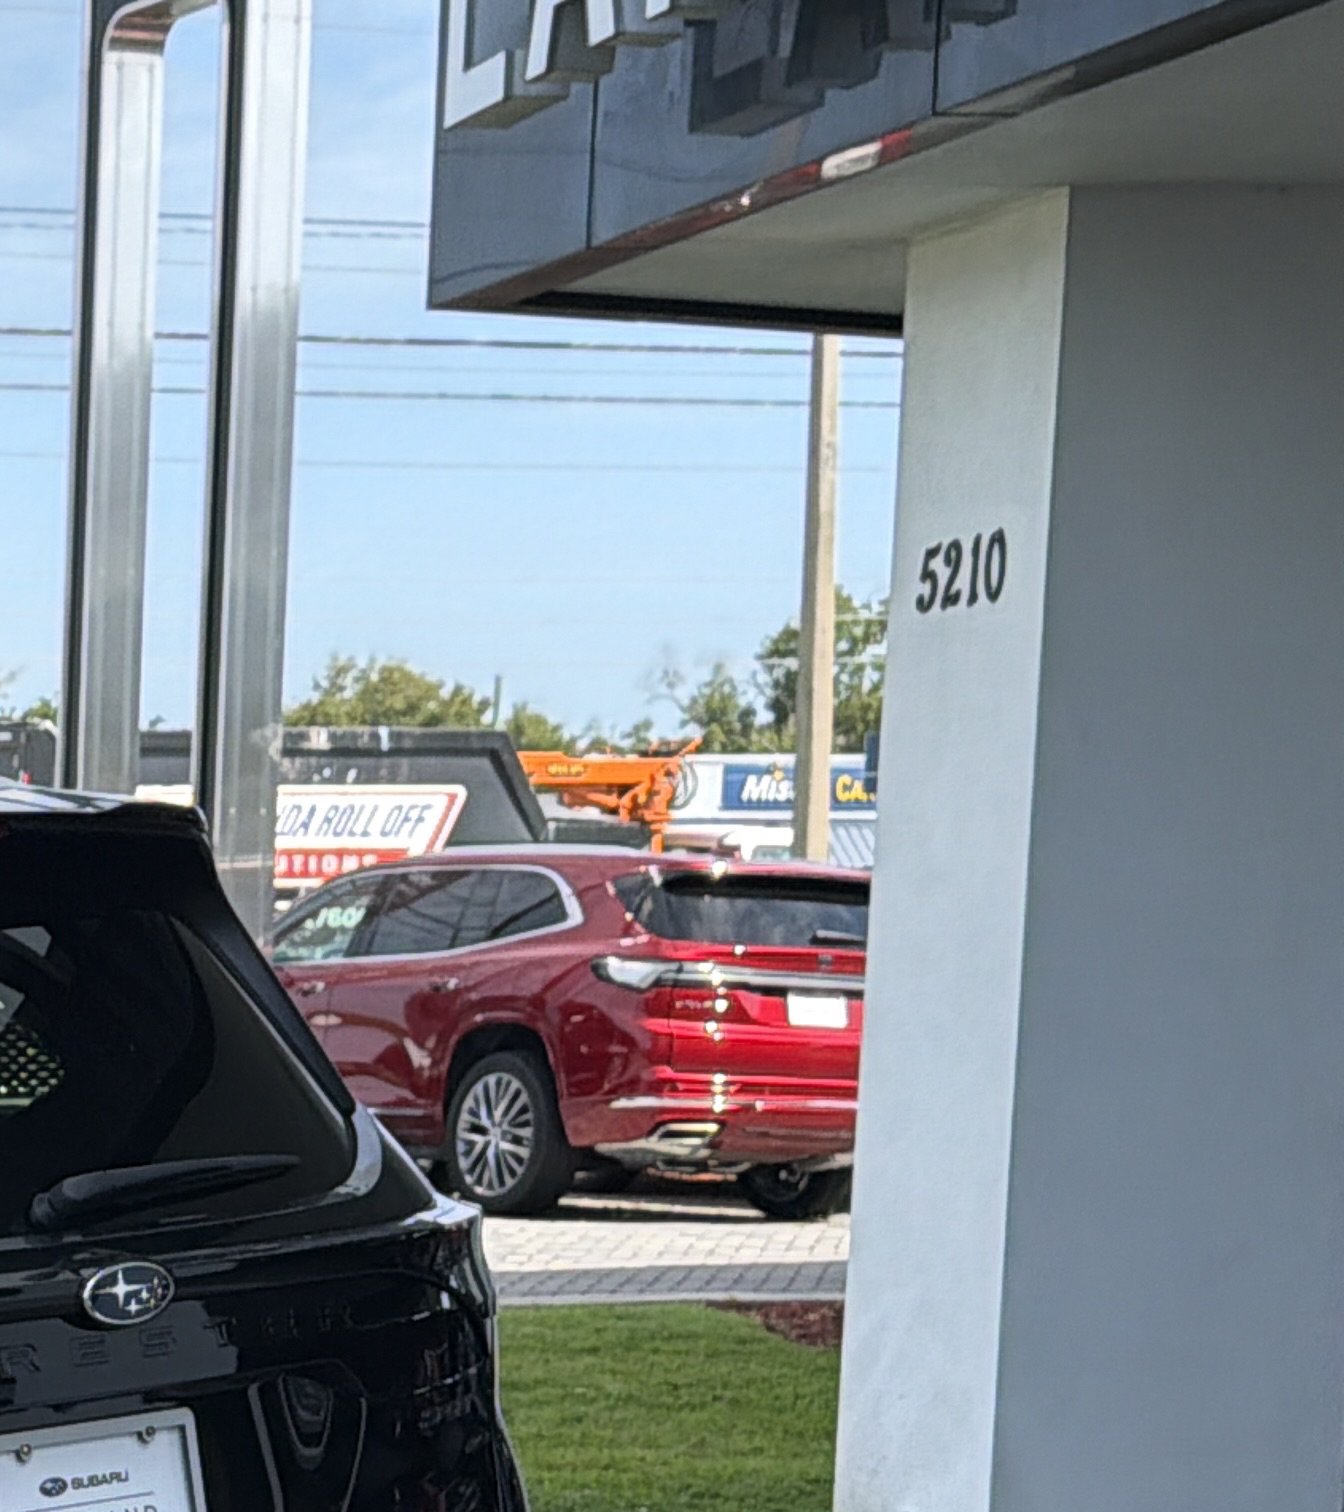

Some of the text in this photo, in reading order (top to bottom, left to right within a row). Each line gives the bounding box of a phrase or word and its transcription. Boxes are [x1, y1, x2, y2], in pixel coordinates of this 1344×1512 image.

[915, 526, 1007, 614] 5210
[741, 773, 795, 802] Mis
[314, 804, 378, 837] ROLL
[379, 804, 434, 838] OFF
[69, 1468, 130, 1491] SUBARU
